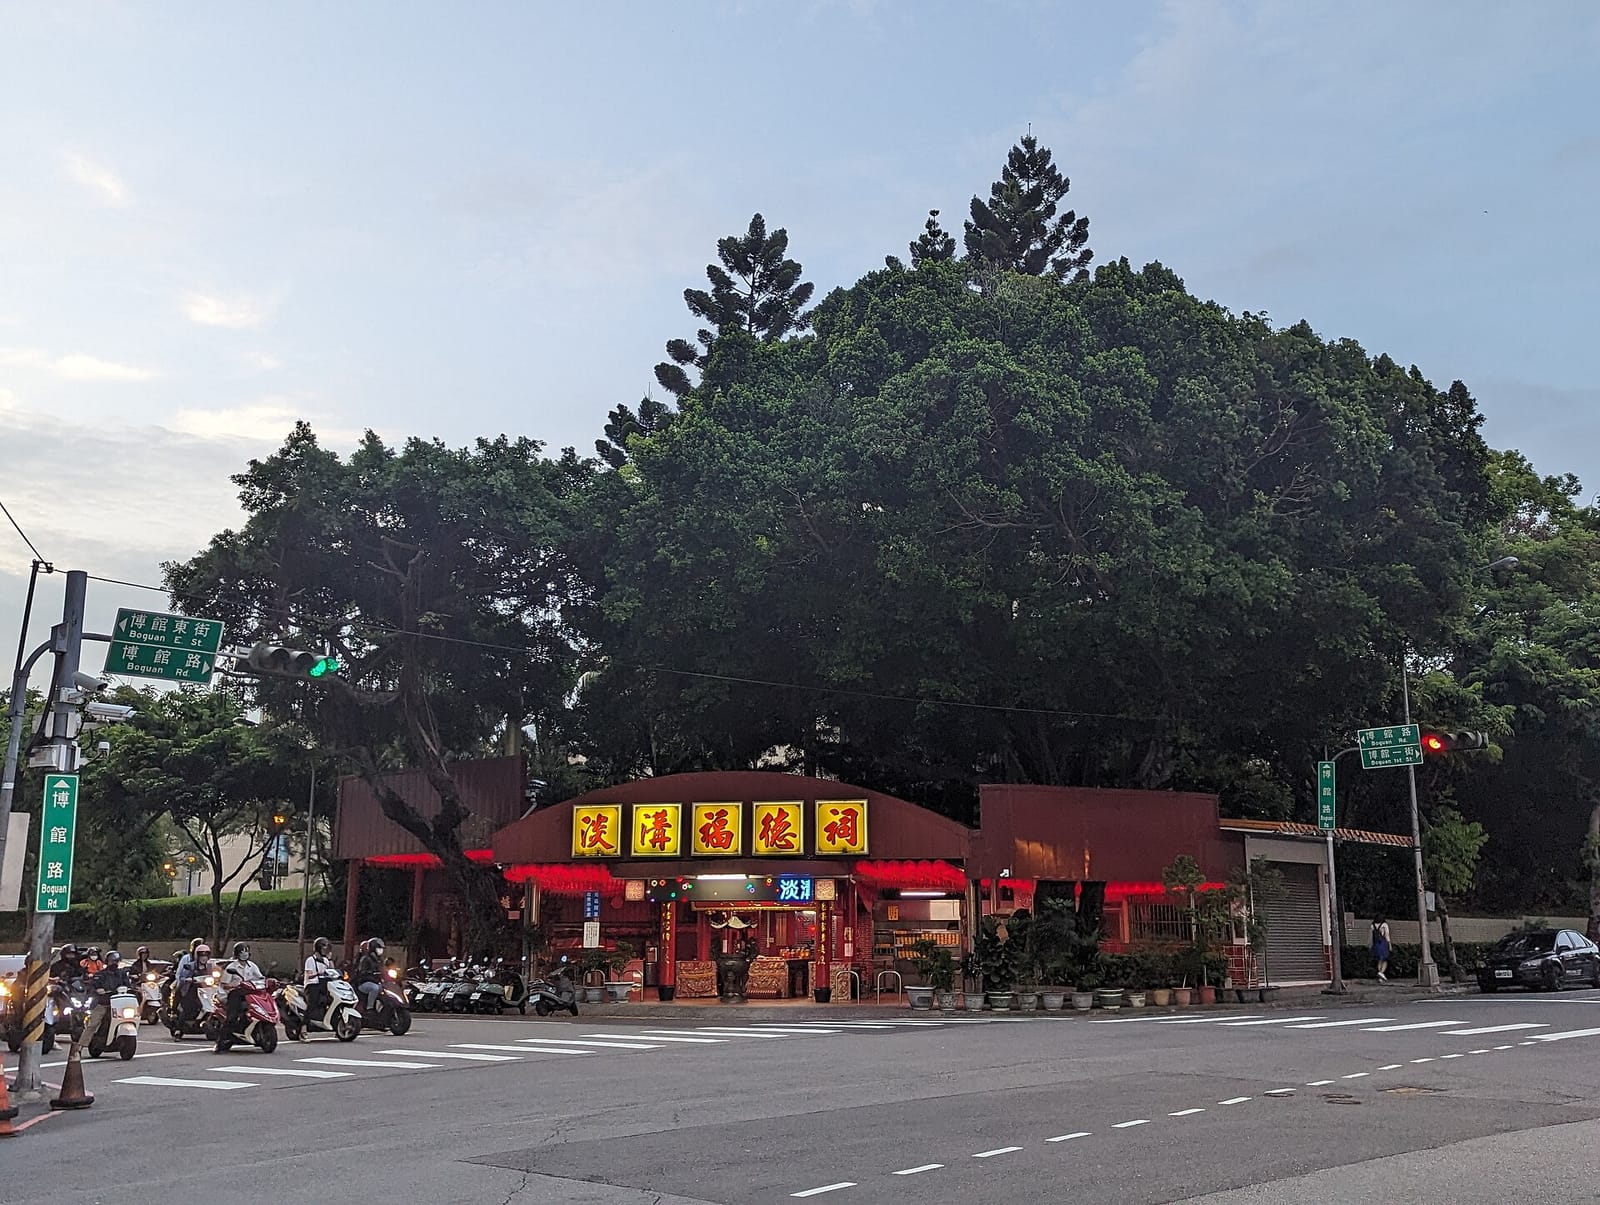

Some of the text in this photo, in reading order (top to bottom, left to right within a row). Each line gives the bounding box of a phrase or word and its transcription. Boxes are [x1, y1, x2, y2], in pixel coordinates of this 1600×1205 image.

[129, 630, 166, 643] Boguan
[130, 612, 211, 638] 博館東街
[122, 645, 202, 669] 博館路
[127, 662, 164, 674] Boguan
[47, 791, 70, 879] 博館路
[580, 807, 859, 851] 淡溝福德祠
[41, 883, 68, 896] Boguan
